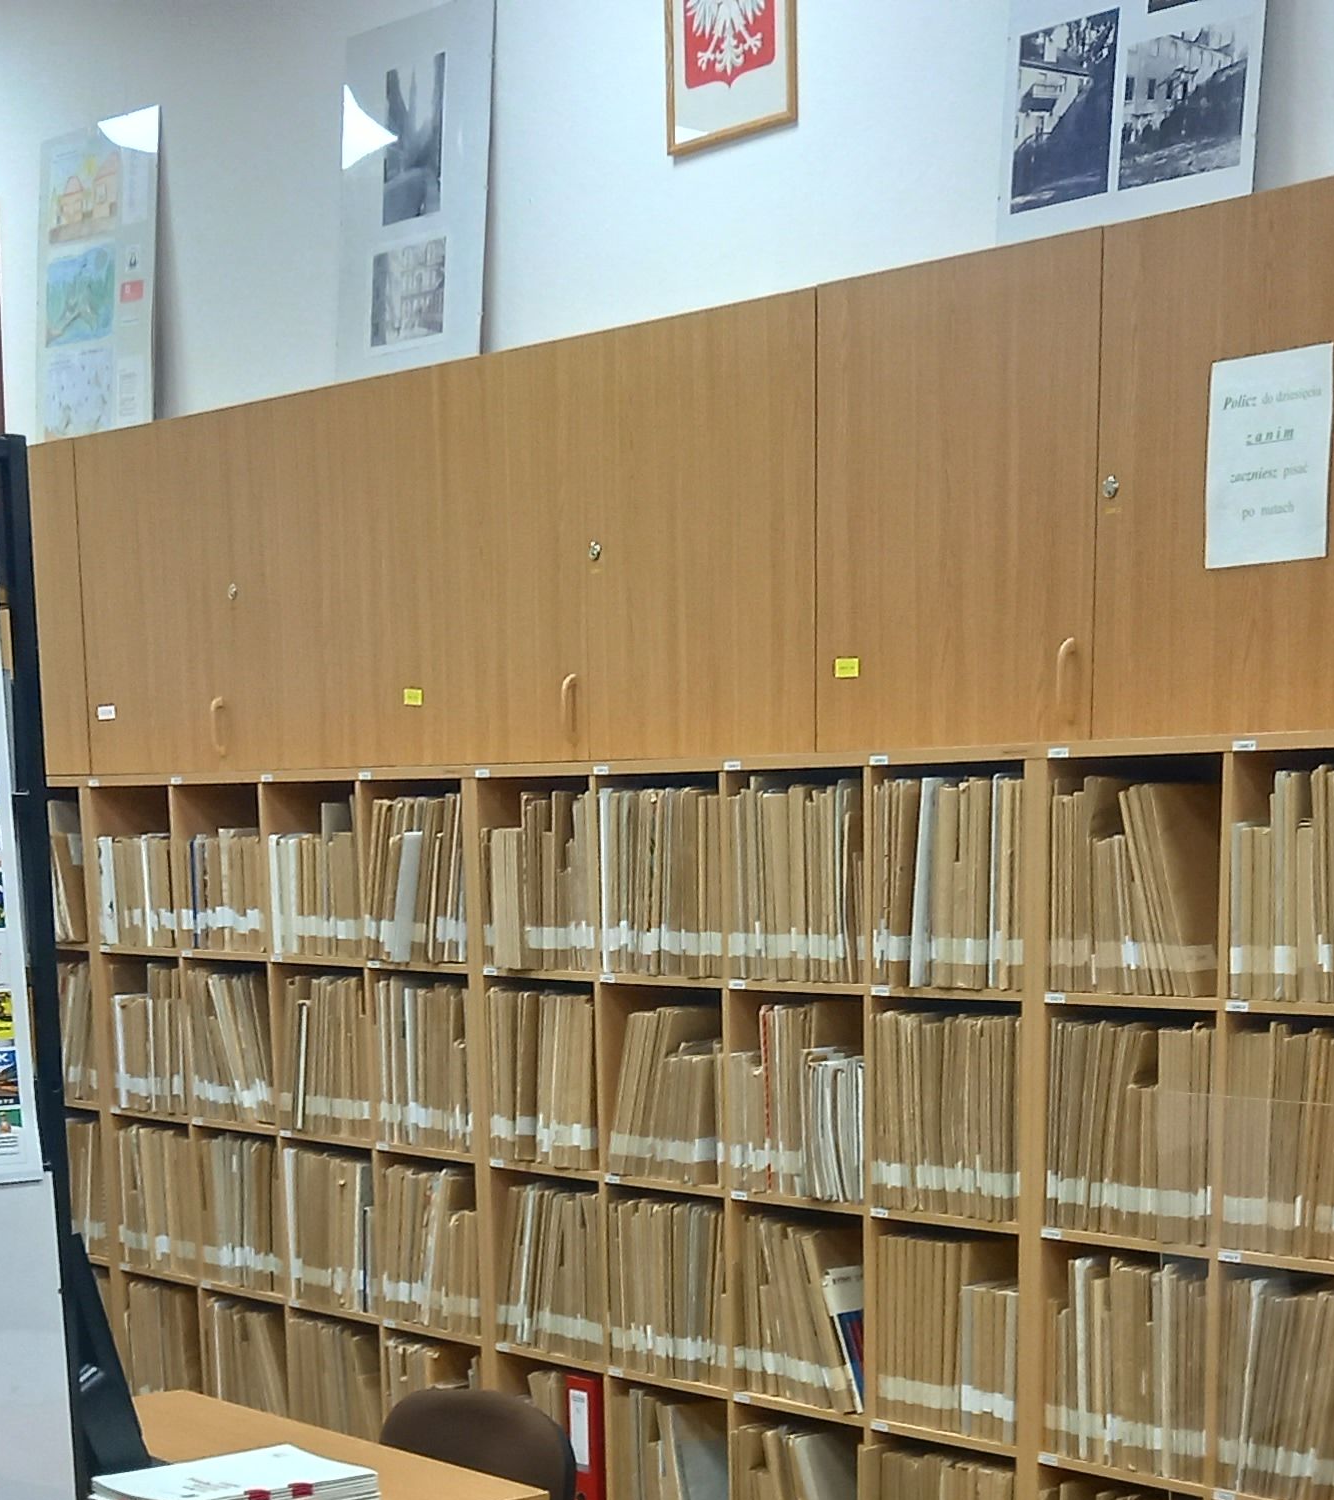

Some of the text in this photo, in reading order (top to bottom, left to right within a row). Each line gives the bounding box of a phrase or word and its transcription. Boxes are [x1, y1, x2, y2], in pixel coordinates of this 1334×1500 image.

[1224, 394, 1257, 411] Policz
[1262, 392, 1273, 405] do
[1246, 428, 1294, 445] zanim
